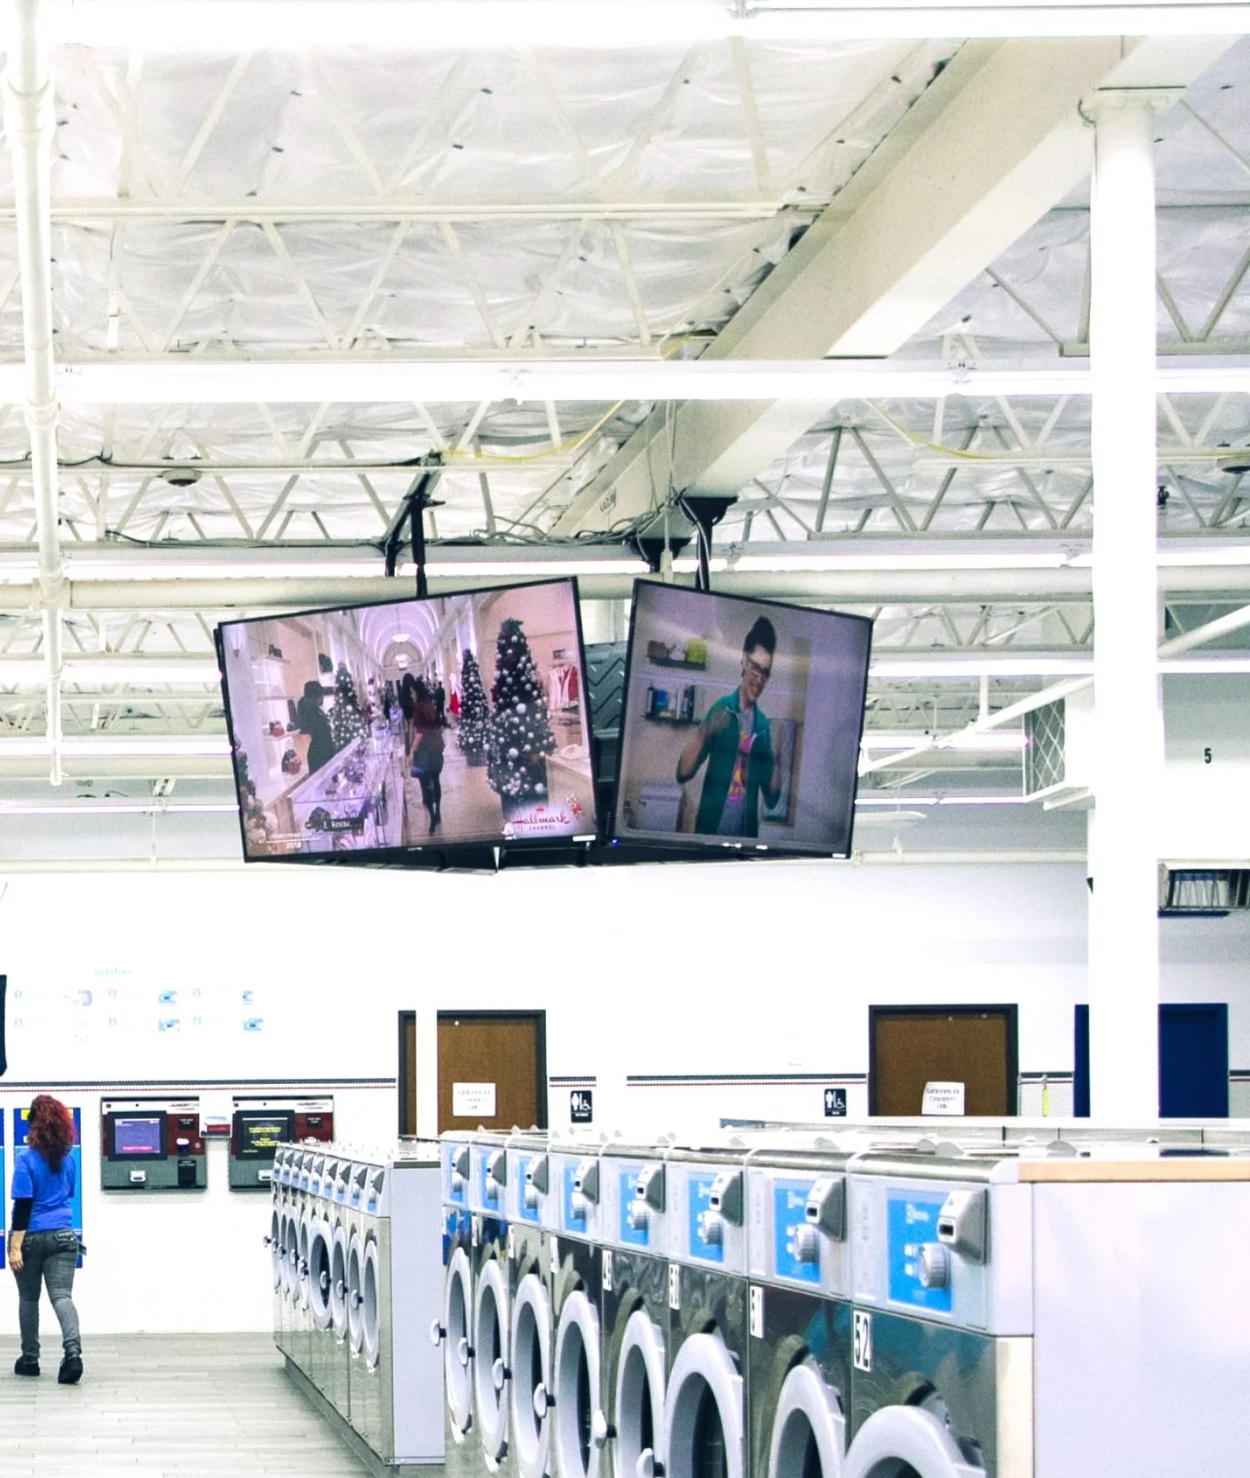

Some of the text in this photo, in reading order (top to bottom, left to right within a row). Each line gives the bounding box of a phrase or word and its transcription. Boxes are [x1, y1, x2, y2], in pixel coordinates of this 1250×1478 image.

[1204, 748, 1213, 763] 5
[752, 1288, 760, 1333] 51
[855, 1314, 869, 1368] 52
